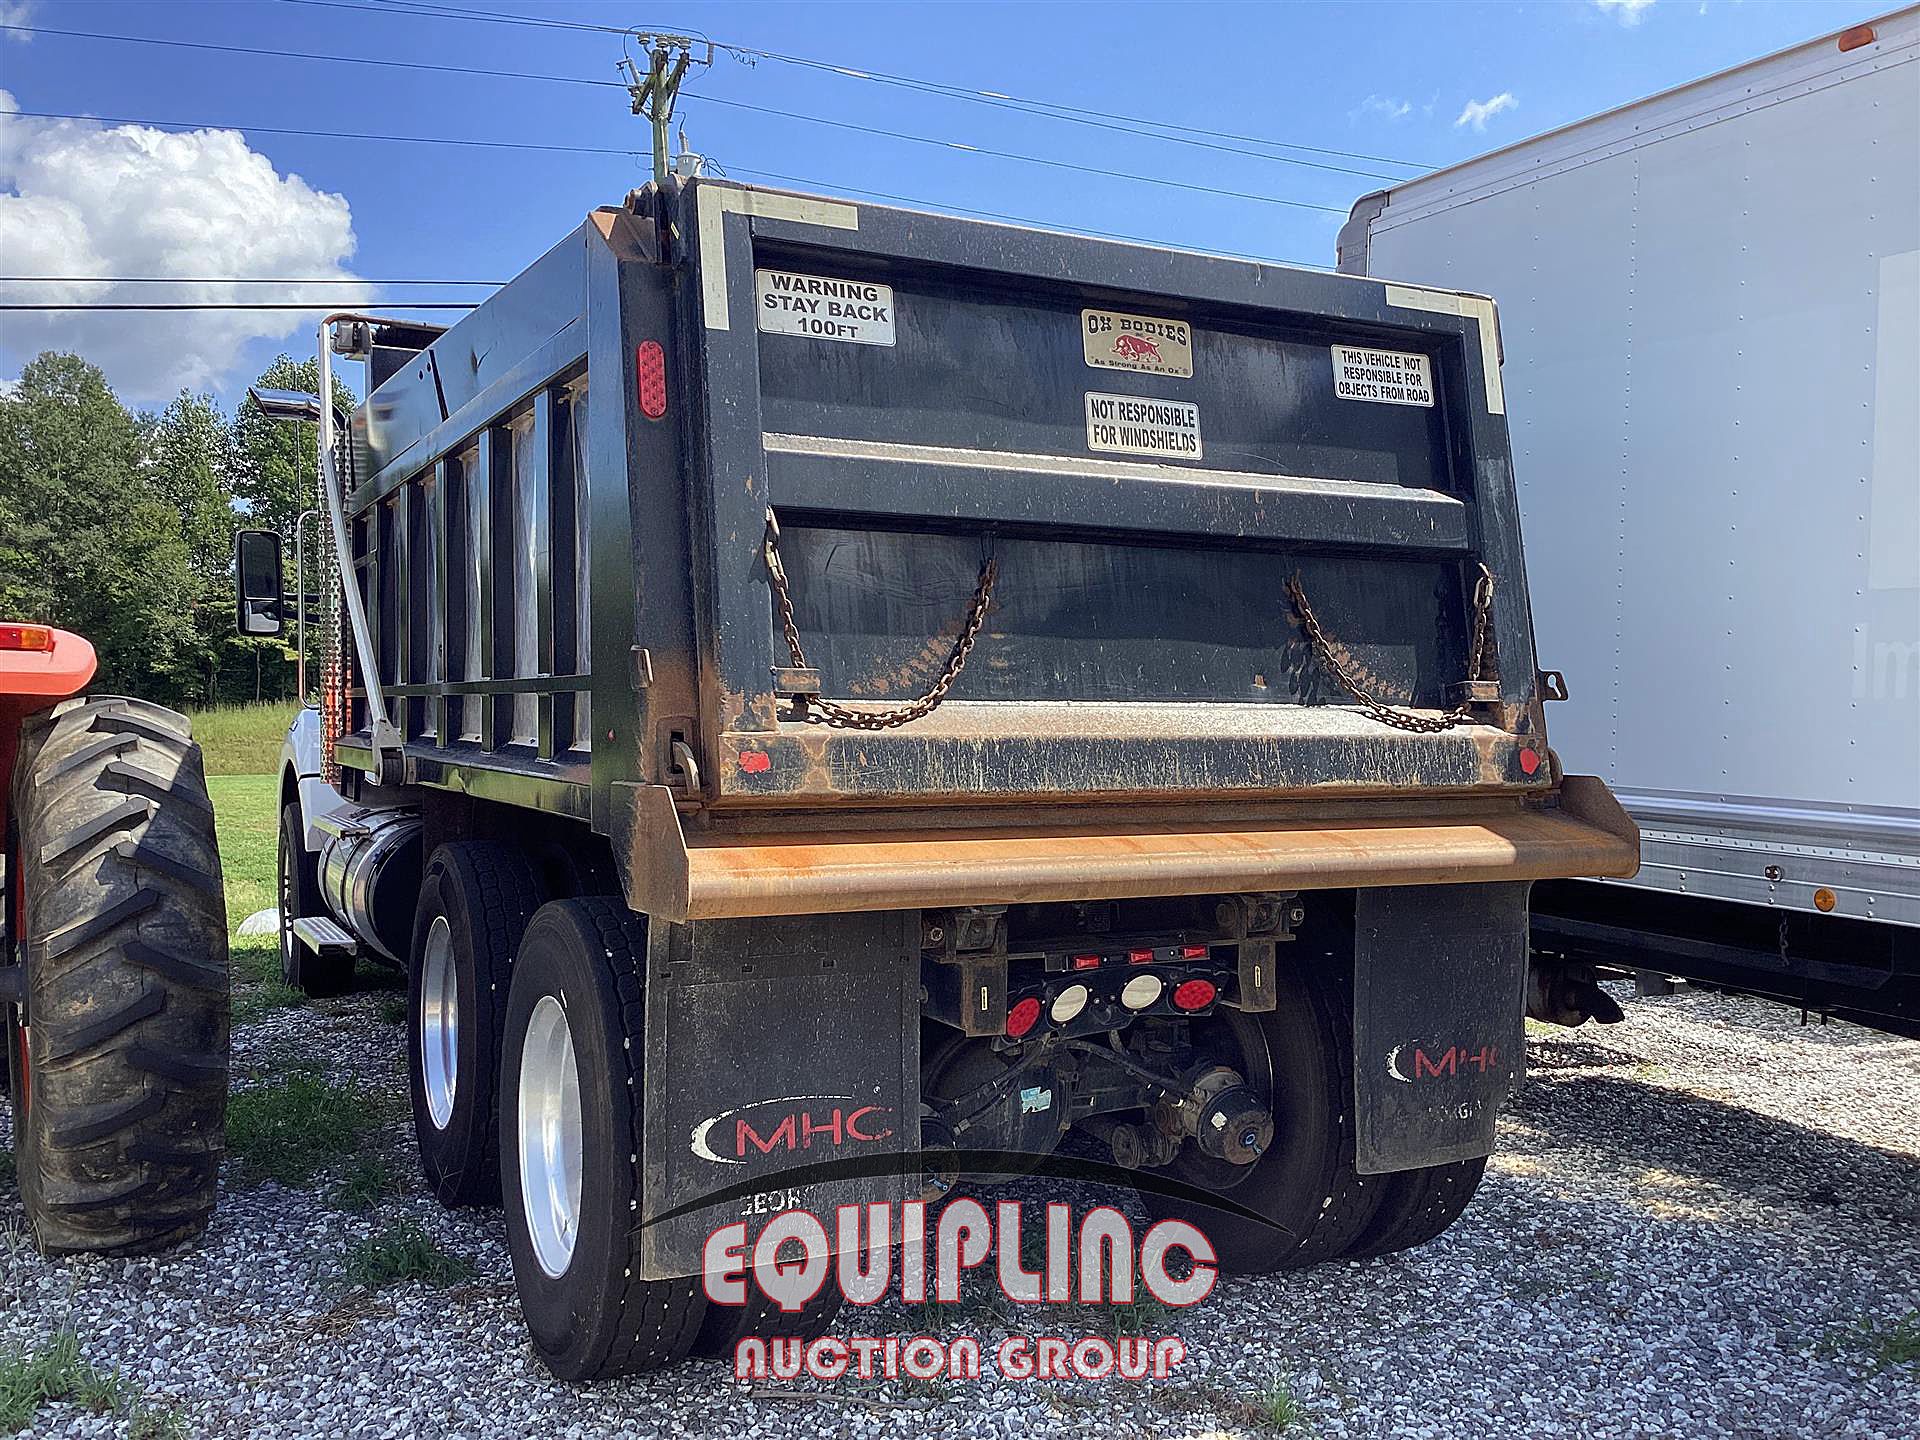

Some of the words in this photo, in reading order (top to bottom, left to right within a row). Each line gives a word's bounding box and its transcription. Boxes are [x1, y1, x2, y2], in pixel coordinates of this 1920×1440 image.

[770, 273, 878, 302] WARNING
[764, 293, 820, 314] STAY
[828, 301, 888, 323] BACK
[798, 317, 858, 338] 100FT
[1088, 315, 1112, 334] OX
[1120, 318, 1187, 346] BODIES
[1109, 359, 1137, 370] Strong
[1141, 363, 1151, 372] As
[1154, 364, 1165, 373] An
[1341, 350, 1362, 364] THIS
[1364, 352, 1401, 369] VEHICLE
[1404, 357, 1421, 371] NOT
[1343, 366, 1402, 385] RESPONSIBLE
[1404, 372, 1422, 387] FOR
[1338, 381, 1378, 398] OBJECTS
[1380, 386, 1404, 401] FROM
[1407, 389, 1430, 403] ROAD
[1091, 399, 1115, 420] NOT
[1118, 401, 1195, 429] RESPONSIBLE
[1093, 423, 1118, 446] FOR
[1120, 427, 1196, 452] WINDSHIELDS
[736, 1104, 895, 1157] MHC
